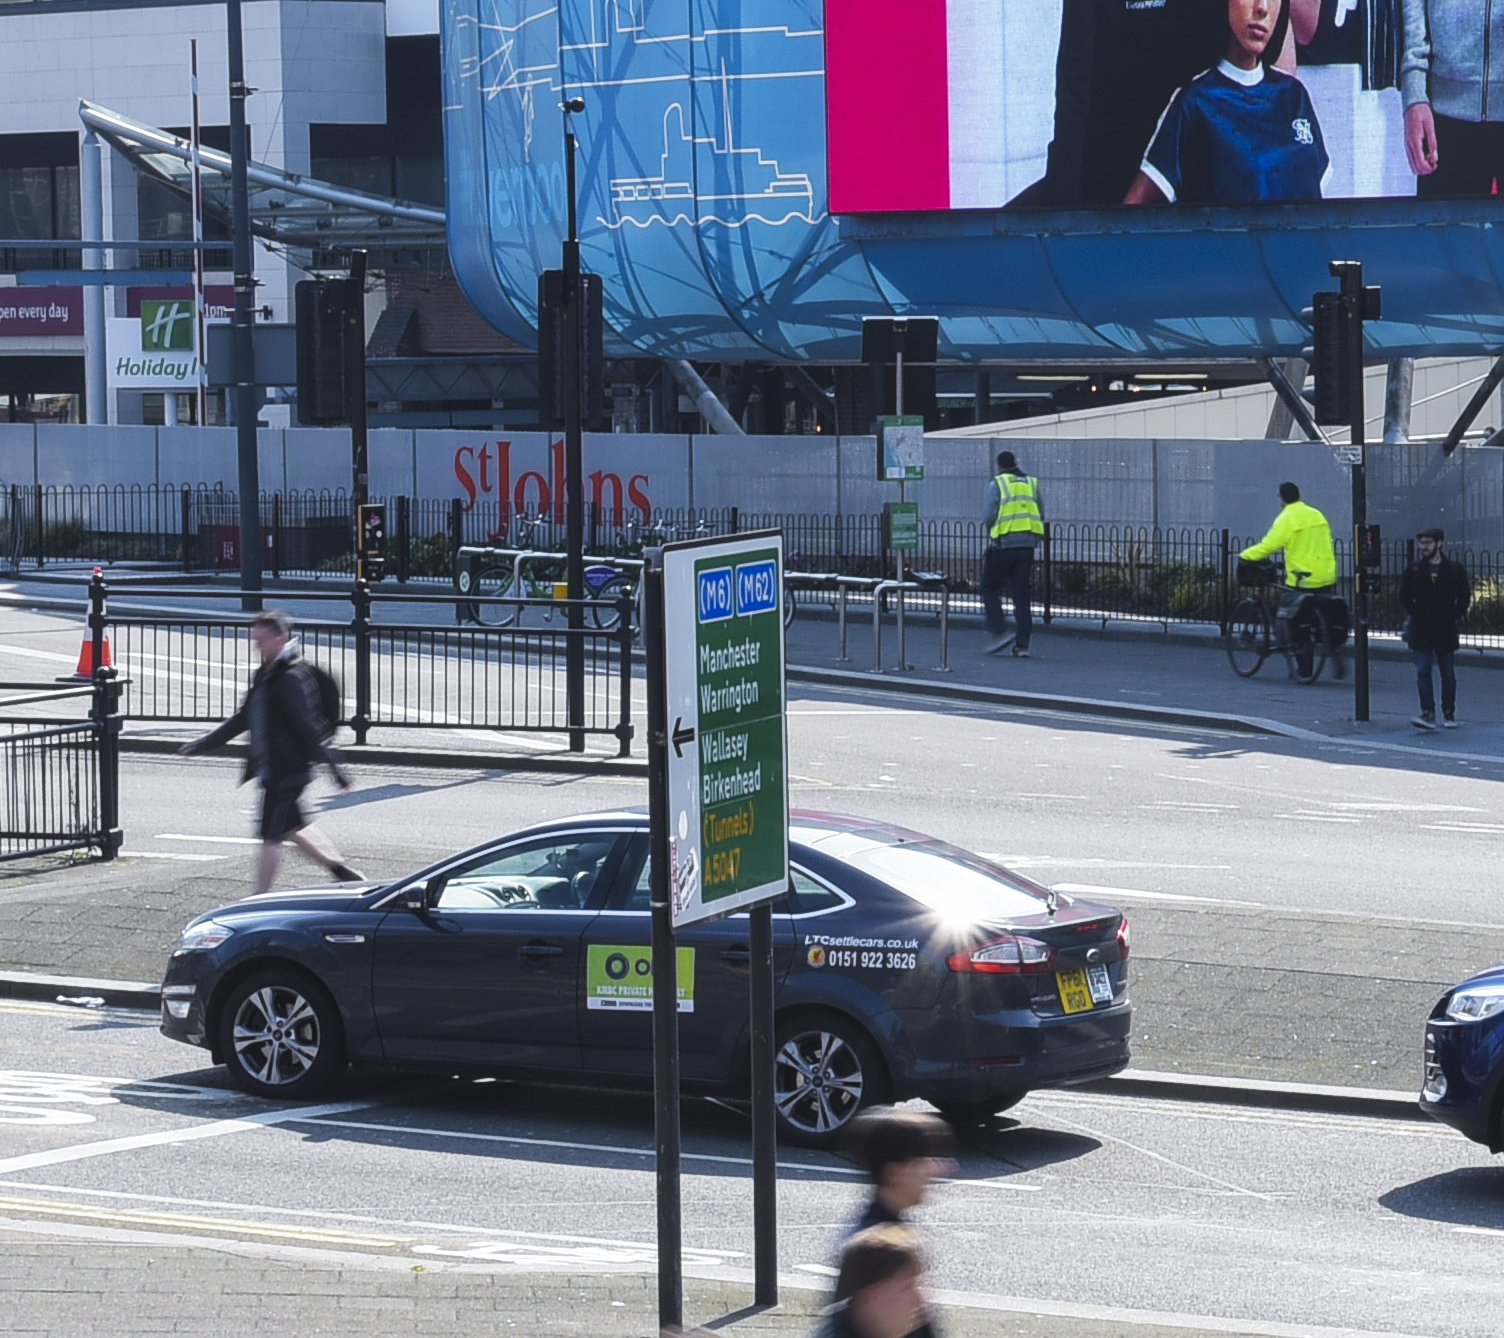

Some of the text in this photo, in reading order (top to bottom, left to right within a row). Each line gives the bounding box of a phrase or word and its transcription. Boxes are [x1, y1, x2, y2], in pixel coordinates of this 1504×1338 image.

[18, 305, 47, 322] every
[49, 302, 69, 323] day
[116, 357, 188, 380] Holiday
[453, 441, 493, 512] St
[701, 563, 775, 620] (M6) (M62)
[700, 639, 760, 674] Manchester
[700, 679, 759, 713] Warrington
[702, 731, 749, 764] Wallasey
[703, 761, 761, 804] Birkenhead
[703, 800, 755, 848] (Tunnels)
[829, 950, 916, 969] 0151 922 3626
